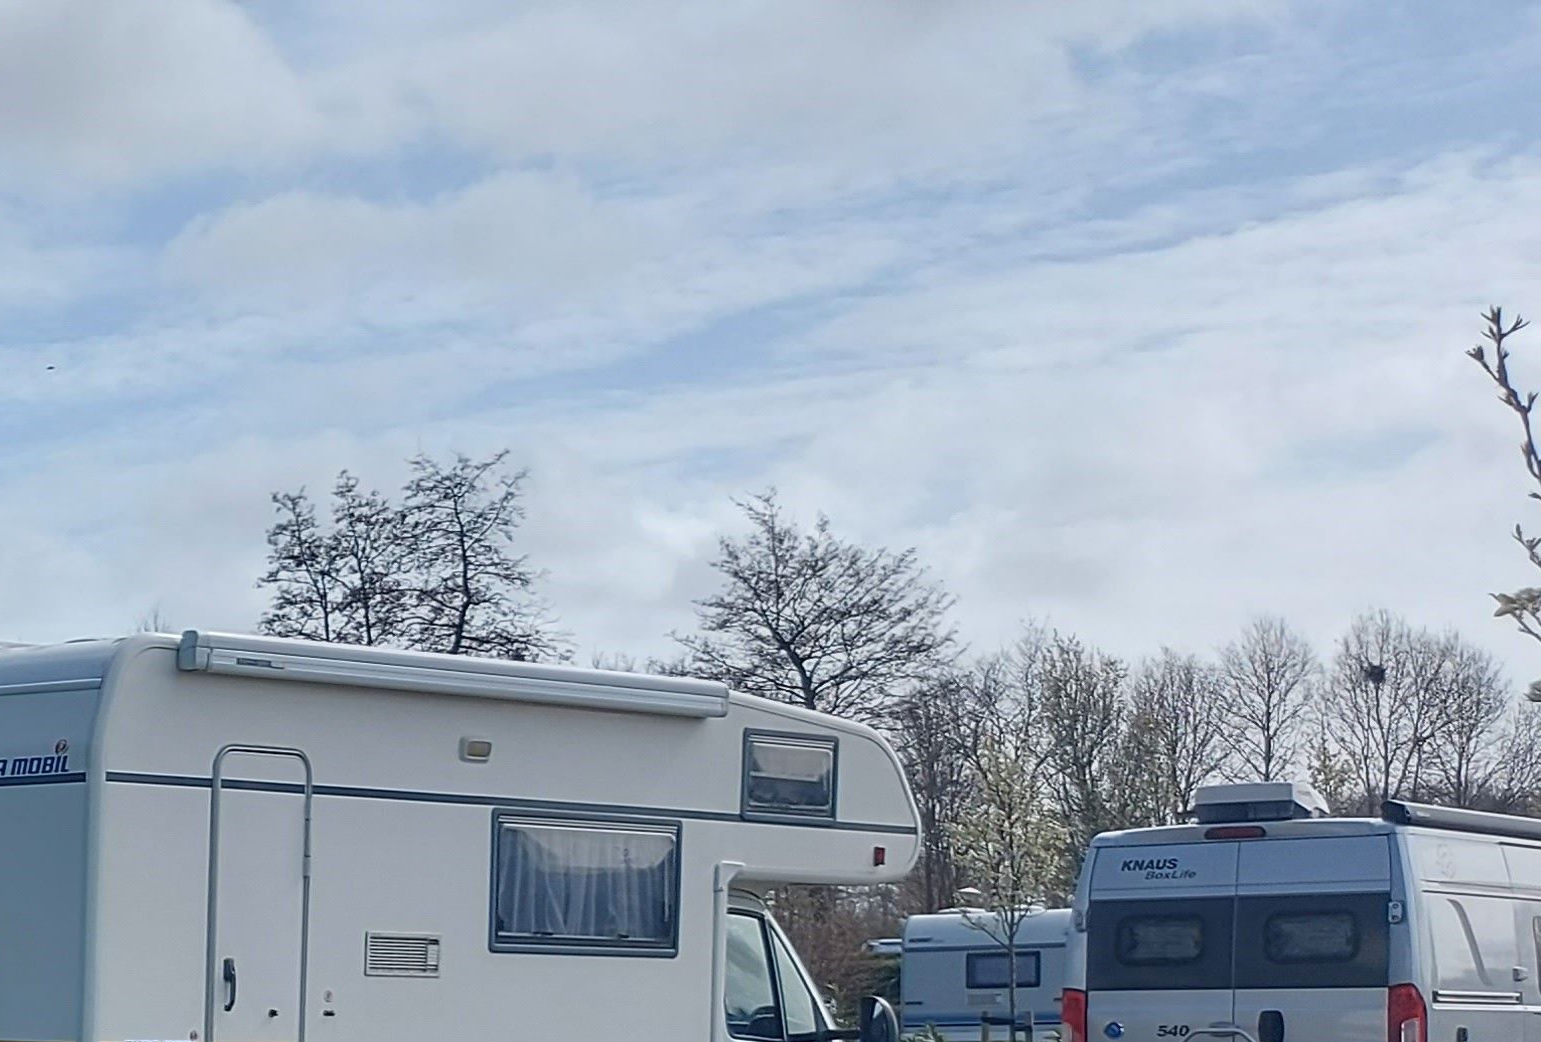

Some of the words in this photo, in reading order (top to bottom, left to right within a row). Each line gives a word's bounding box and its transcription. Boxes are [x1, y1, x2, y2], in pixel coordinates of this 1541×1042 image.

[10, 754, 70, 776] MOBIL
[1120, 857, 1179, 872] KNAUS
[1144, 868, 1197, 881] BoxLife
[1156, 1024, 1190, 1037] 540
